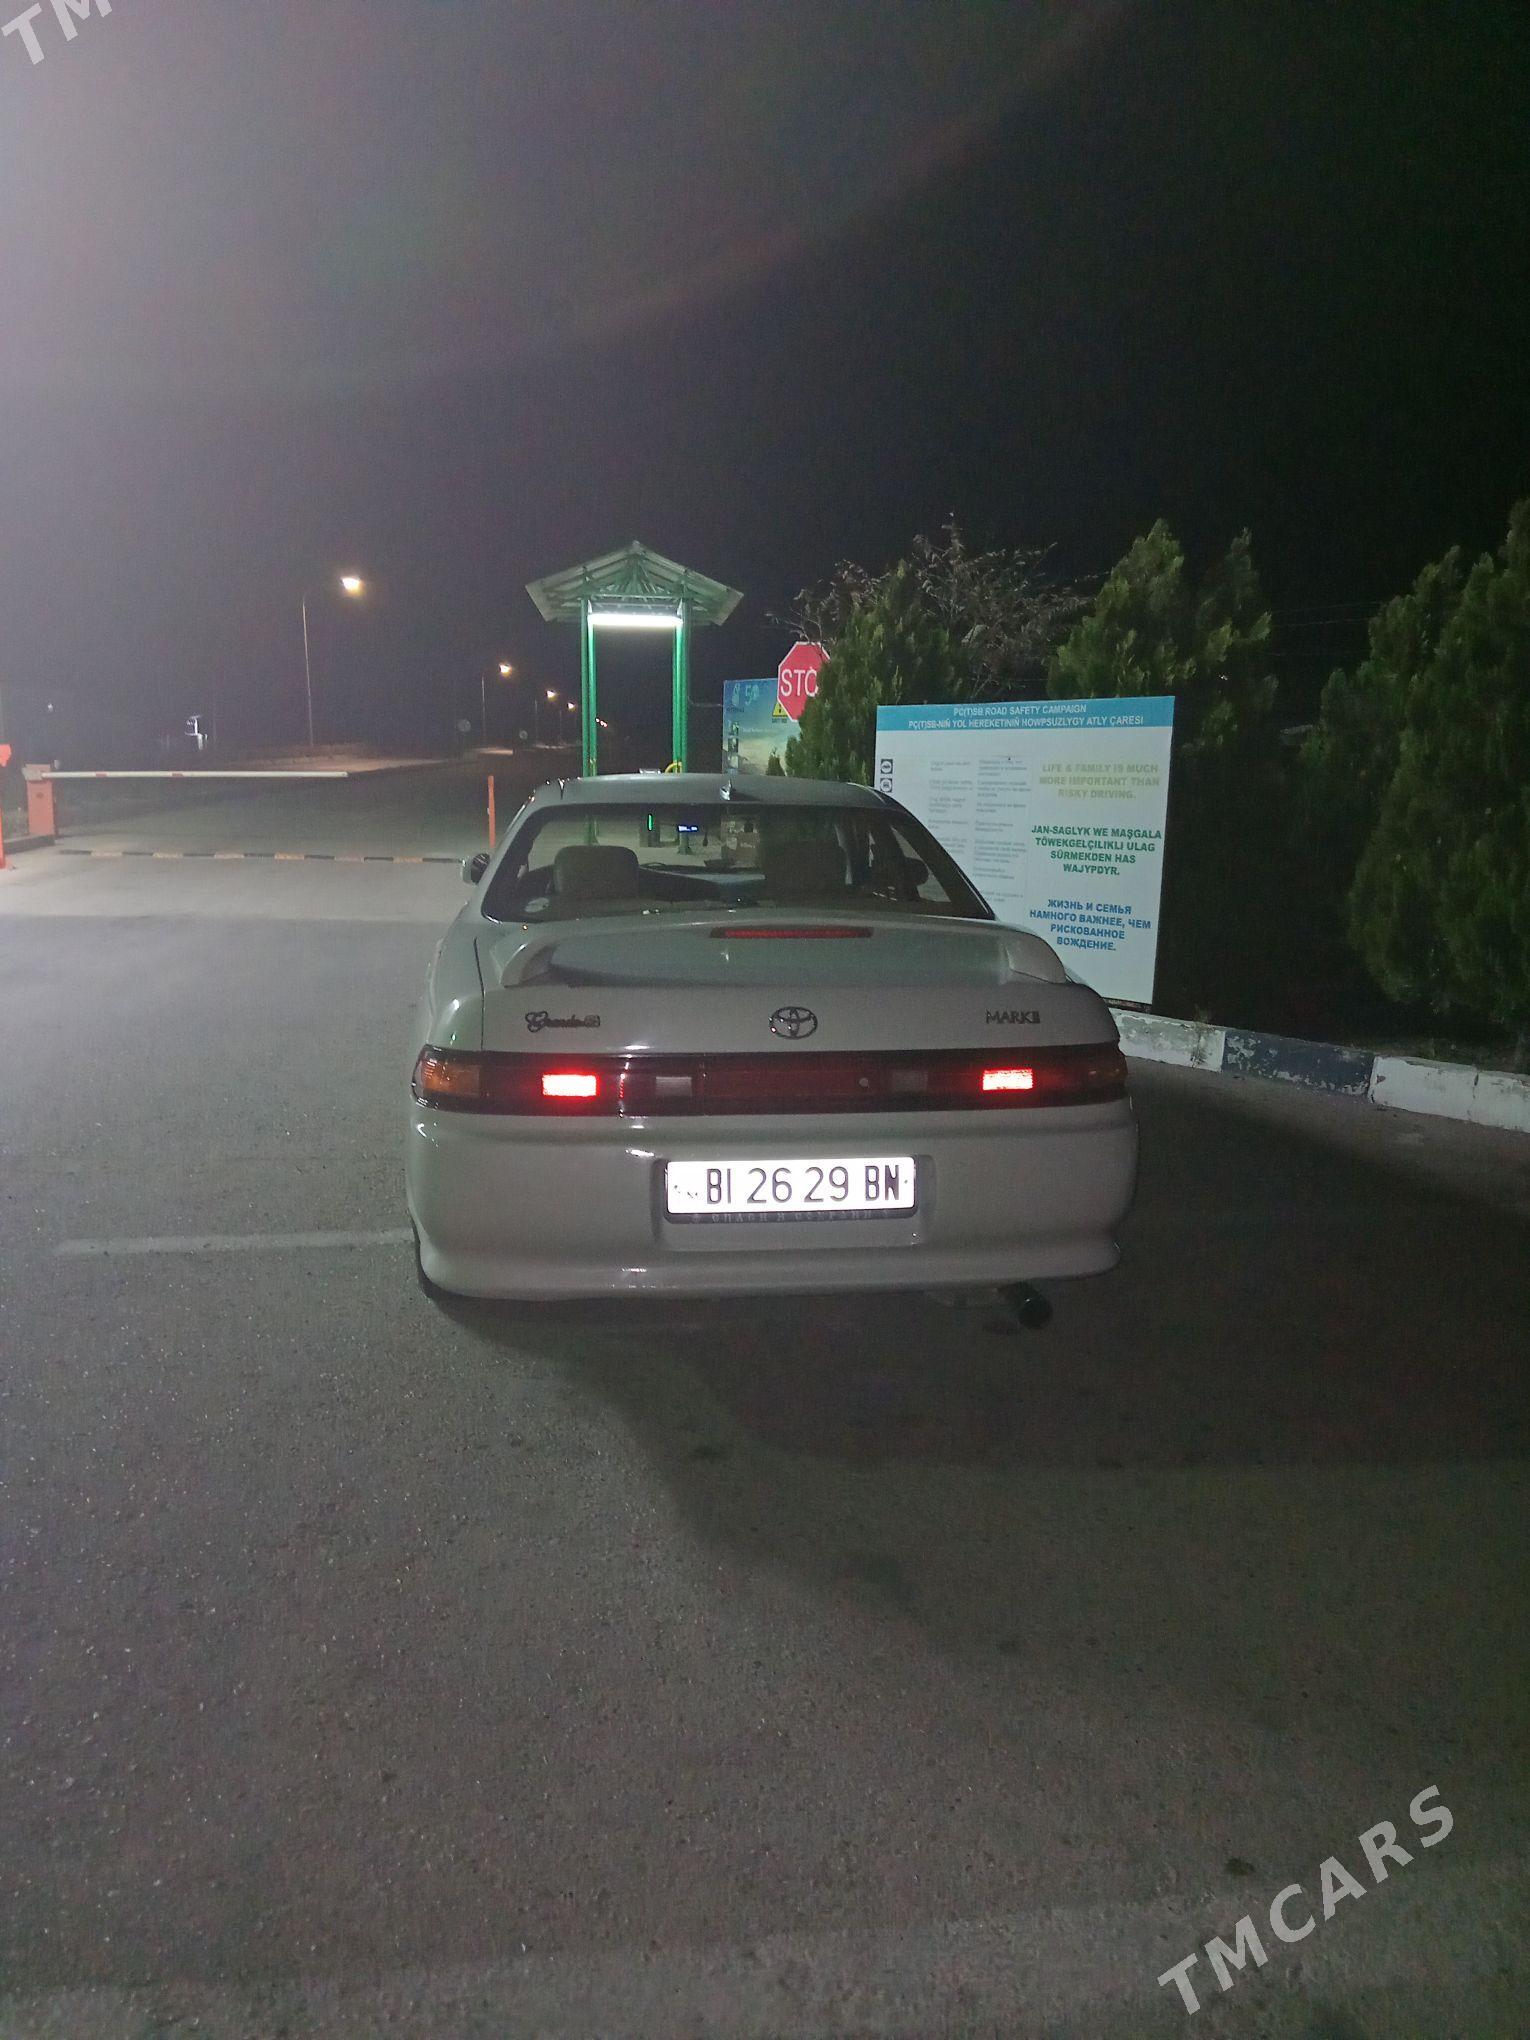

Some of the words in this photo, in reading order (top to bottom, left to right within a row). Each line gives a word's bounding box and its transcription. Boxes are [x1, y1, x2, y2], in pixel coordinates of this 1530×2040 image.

[781, 668, 819, 697] STO
[985, 706, 1007, 716] ROAD
[1009, 705, 1041, 715] SAFETY
[1042, 704, 1087, 714] CAMPAIGN
[952, 719, 967, 728] YOL
[1021, 716, 1085, 727] HOWPSUZLYGY
[1086, 716, 1108, 726] ATLY
[1109, 715, 1144, 726] ÇARESI
[1042, 763, 1063, 773] LIFE
[1065, 763, 1072, 773] &
[1074, 763, 1111, 773] FAMILY
[1113, 763, 1123, 773] IS
[1127, 763, 1159, 773] MUCH
[1039, 776, 1065, 785] MORE
[1069, 776, 1127, 786] IMPORTANT
[1131, 777, 1160, 786] THAN
[1057, 789, 1088, 798] RISKY
[1090, 789, 1136, 799] DRIVING.
[1031, 825, 1091, 836] JAN-SAGLYK
[1092, 827, 1108, 837] WE
[1110, 829, 1162, 840] MAŞGALA
[1035, 837, 1124, 850] TÖWEKGELÇILIKLI
[1126, 842, 1155, 852] ULAG
[1050, 850, 1112, 863] SÜRMEKDEN
[1114, 854, 1136, 864] HAS
[1063, 864, 1120, 876] WAJYPDYR.
[1047, 899, 1083, 910] ЖИЗНЬ
[1085, 902, 1093, 911] И
[1095, 904, 1132, 915] СЕМЬЯ
[1029, 910, 1077, 922] НАМНОГО
[1079, 915, 1126, 928] ВАЖНЕЕ,
[1128, 919, 1151, 929] ЧЕМ
[1050, 924, 1125, 939] РИСКОВАННОЕ
[1056, 936, 1117, 951] ВОЖДЕНИЕ.
[706, 1168, 732, 1204] BI
[864, 1164, 900, 1201] BN
